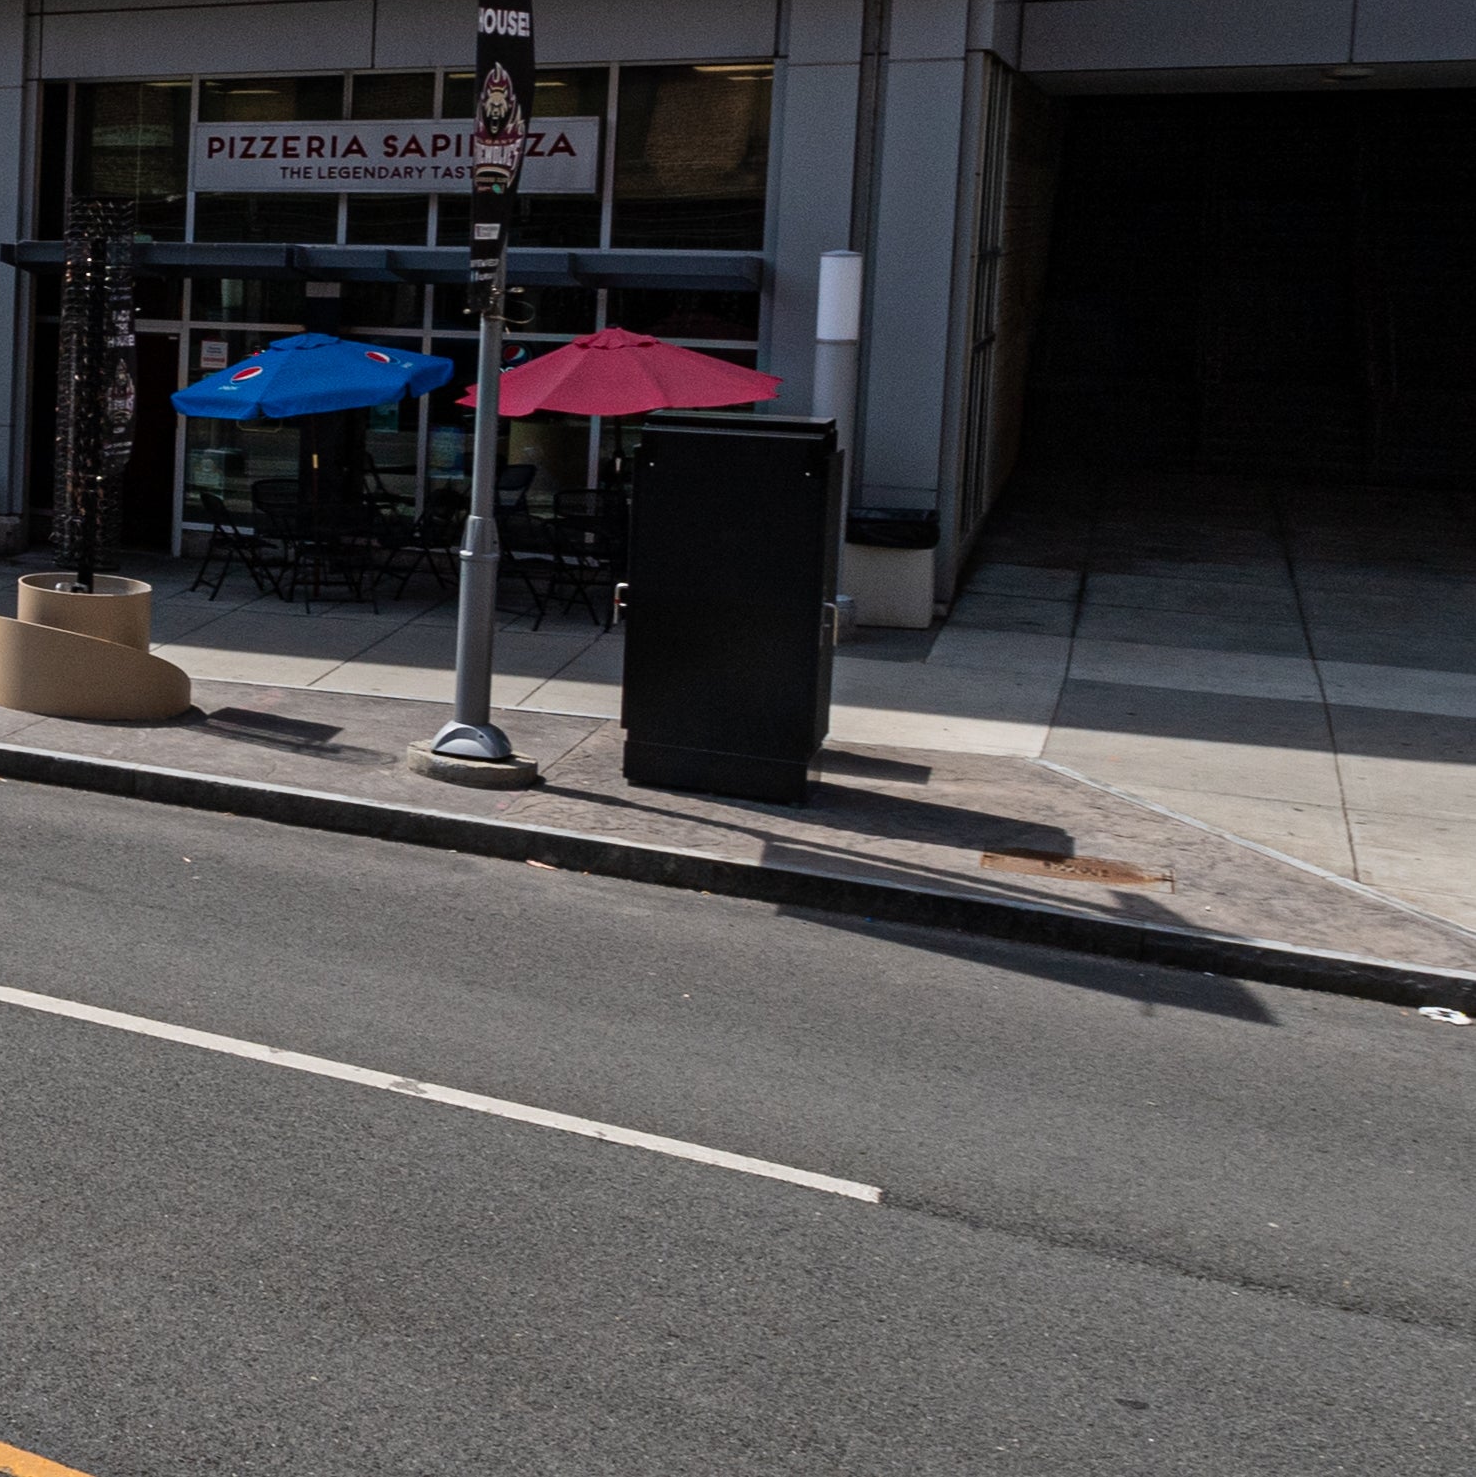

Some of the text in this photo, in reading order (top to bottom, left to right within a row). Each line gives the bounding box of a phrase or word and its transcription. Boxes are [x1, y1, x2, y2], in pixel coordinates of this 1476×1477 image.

[207, 135, 369, 160] PIZZERIA
[382, 132, 578, 159] SAPIZA
[279, 166, 313, 180] THE
[317, 166, 426, 180] LEGENDARY
